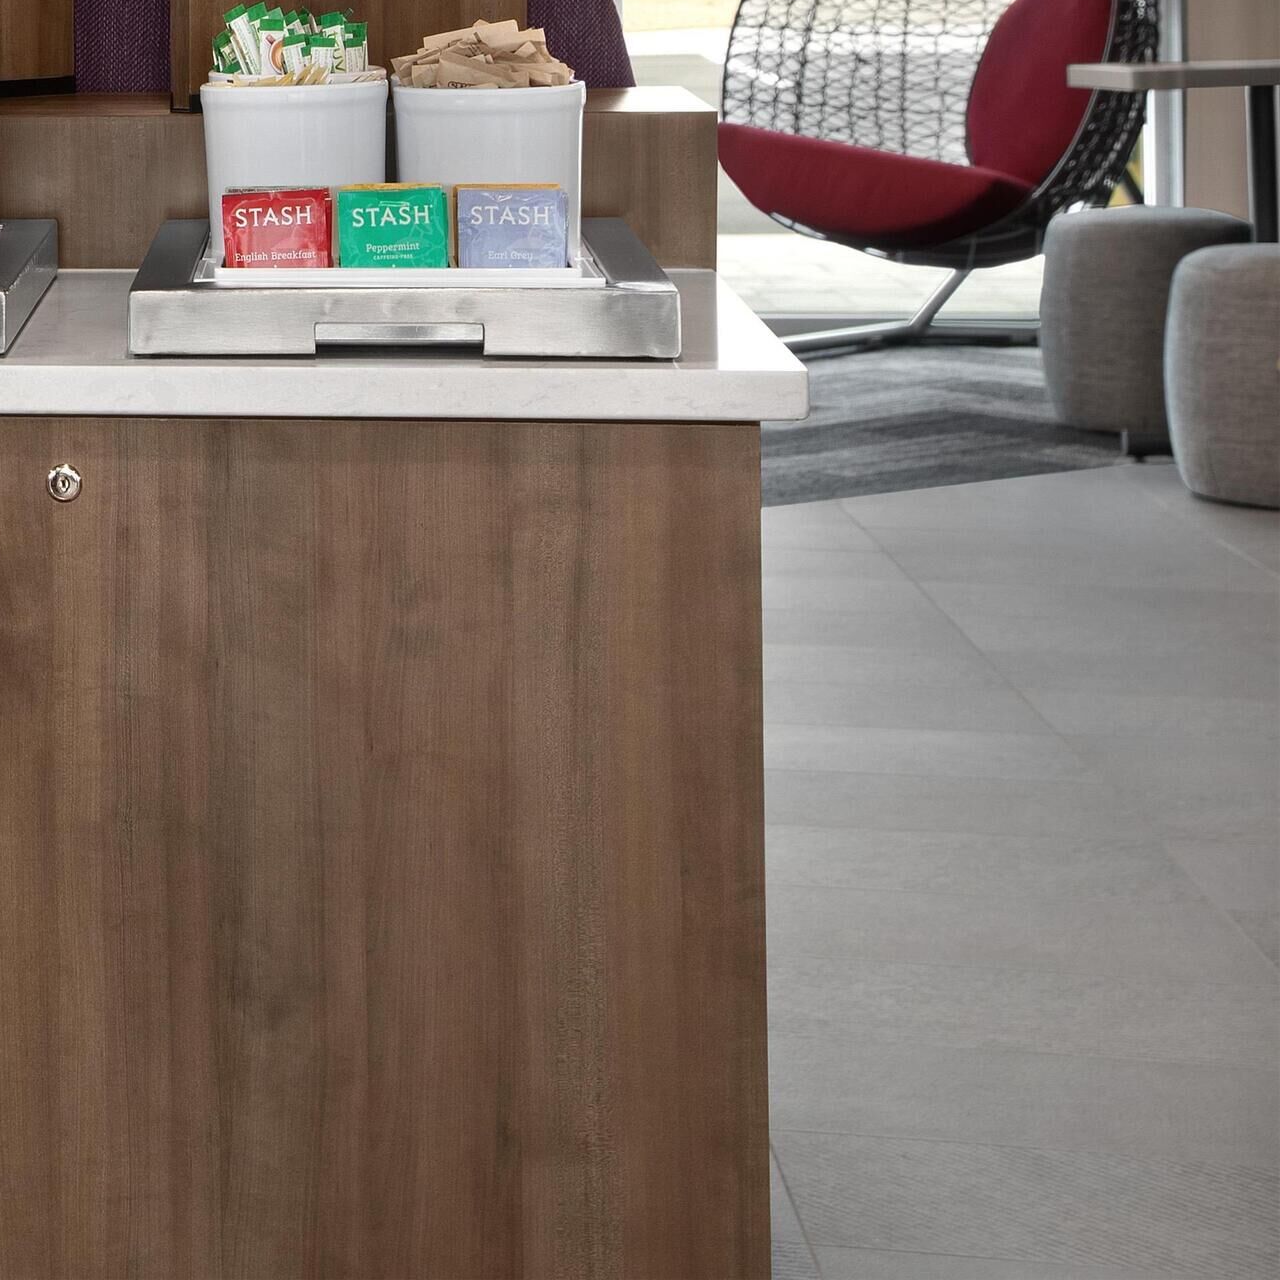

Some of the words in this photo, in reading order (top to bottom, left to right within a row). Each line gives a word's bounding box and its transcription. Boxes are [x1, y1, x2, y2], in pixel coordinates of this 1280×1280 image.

[235, 205, 313, 228] STASH
[351, 205, 431, 228] STASH
[470, 206, 550, 226] STASH
[234, 251, 269, 263] English
[270, 249, 317, 261] Breakfast
[365, 241, 420, 254] Peppermint
[487, 250, 509, 261] Earl
[510, 251, 534, 263] Grey
